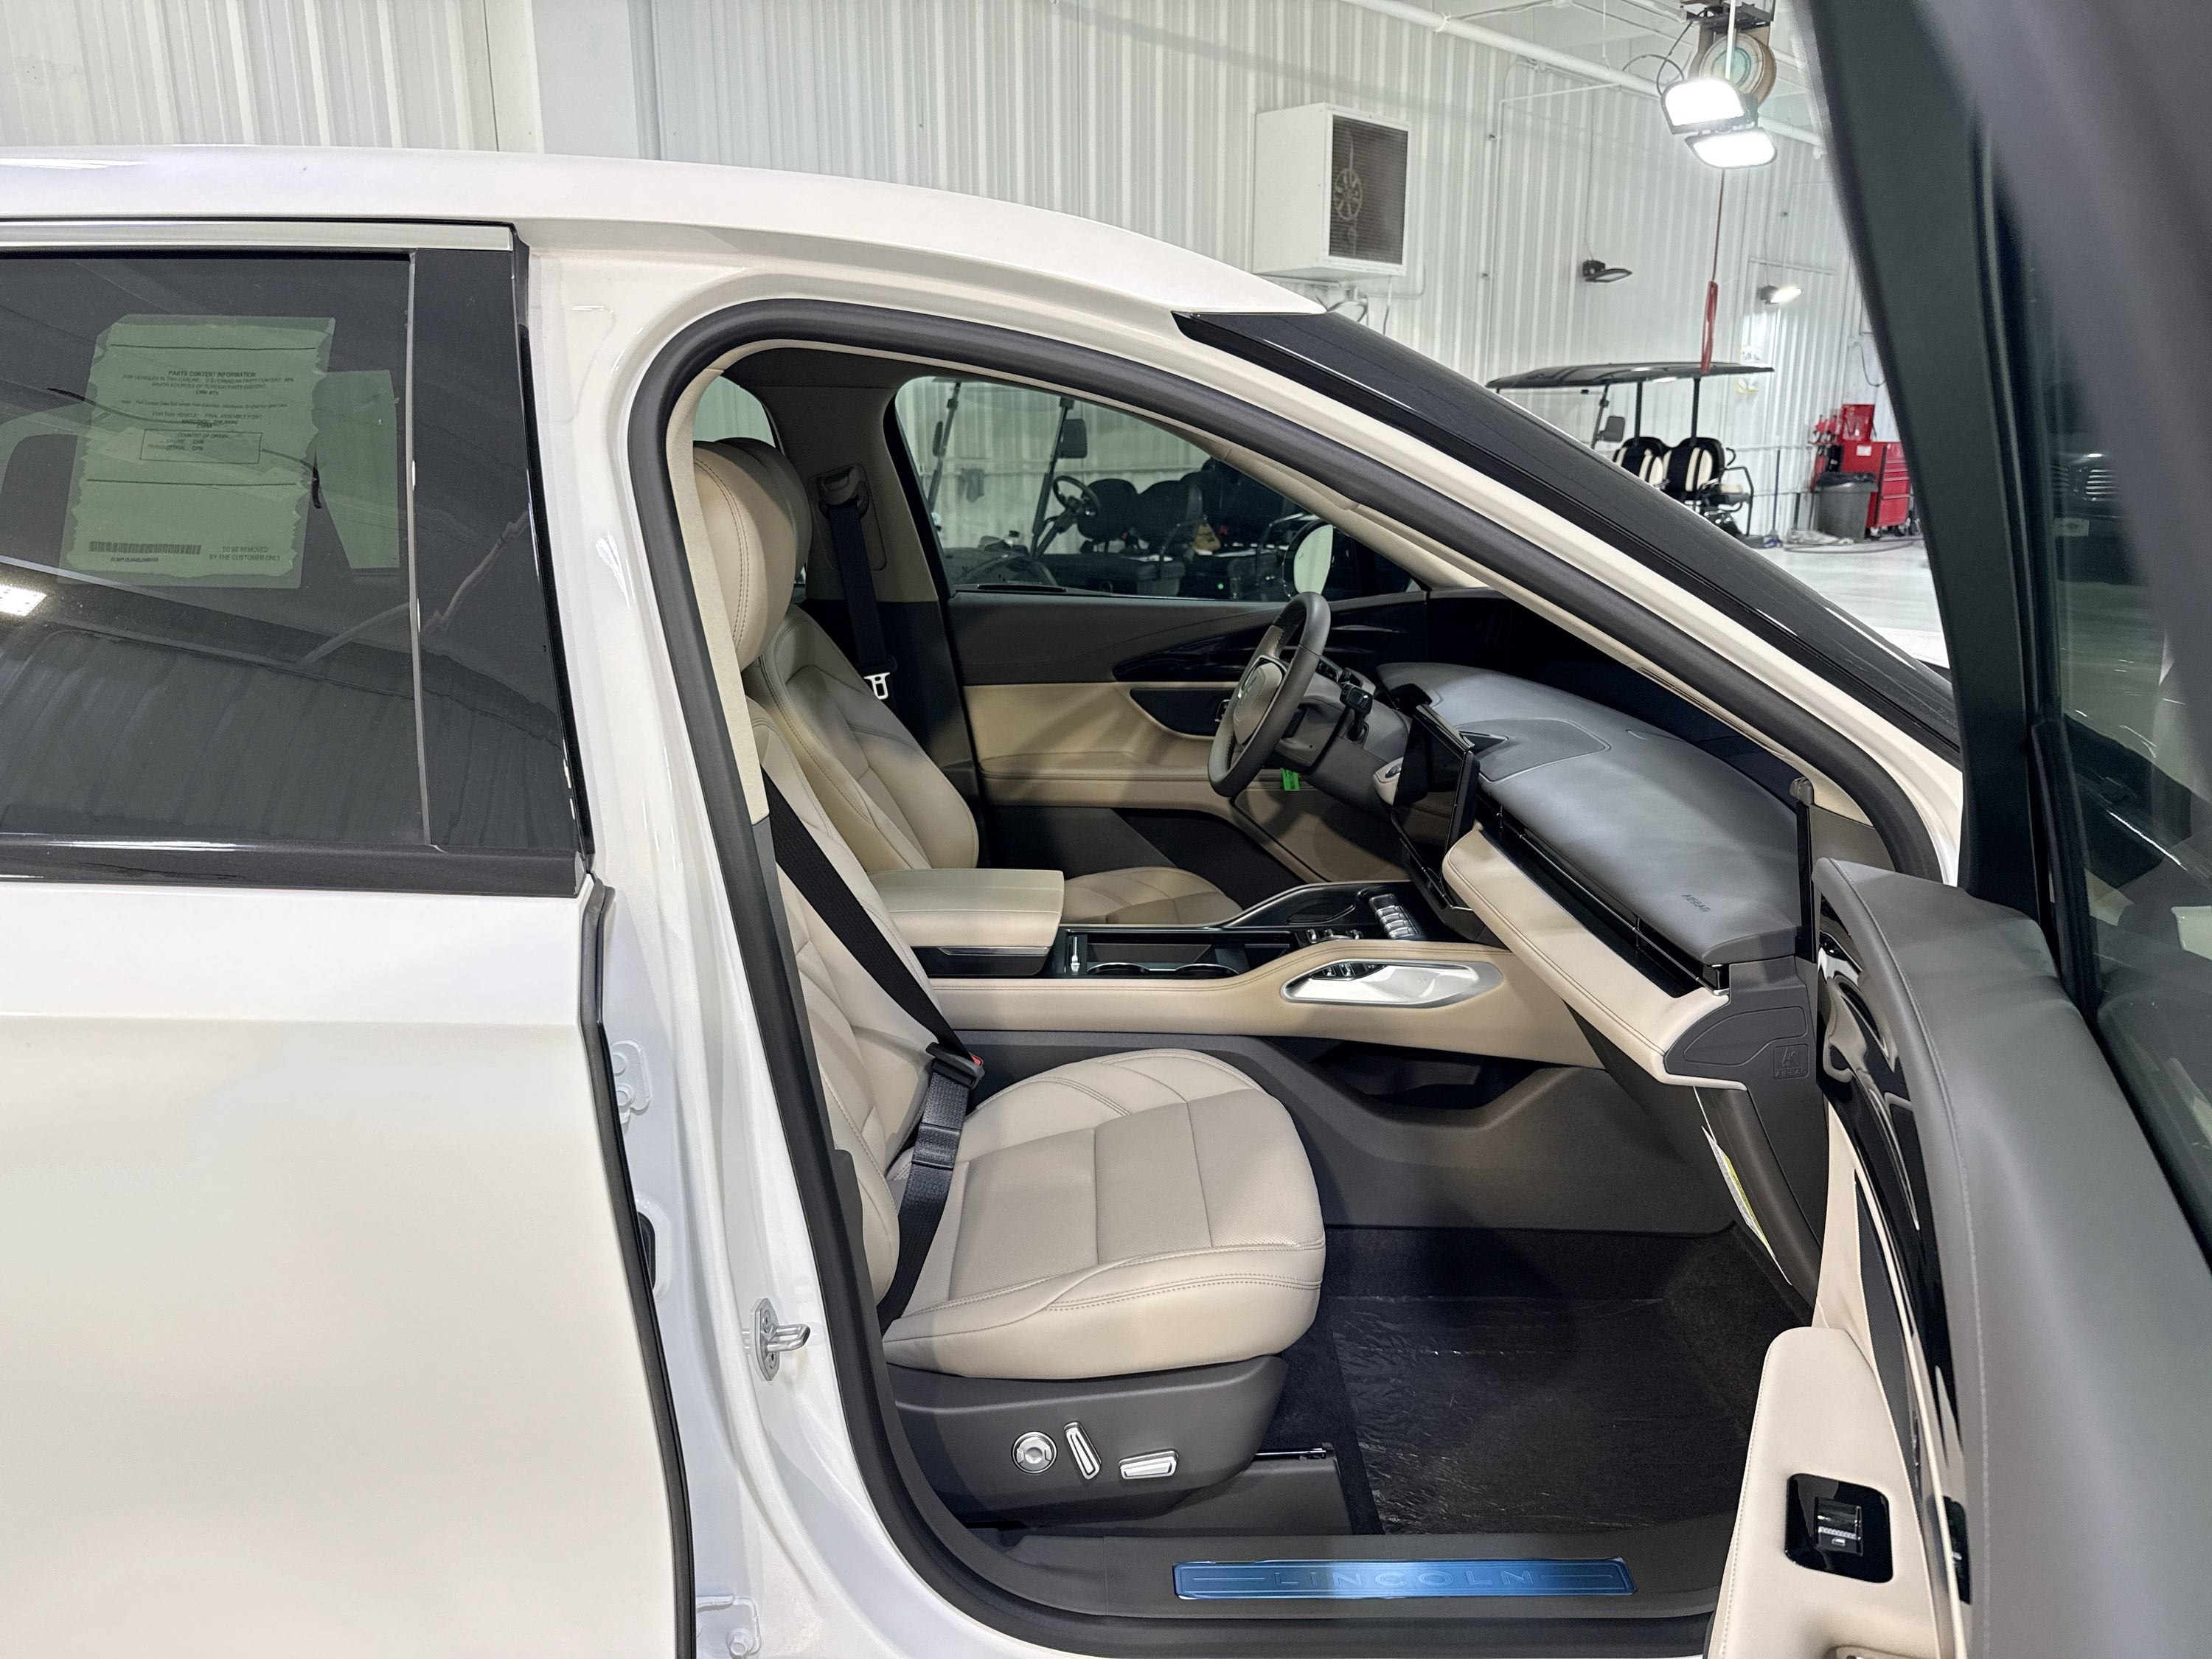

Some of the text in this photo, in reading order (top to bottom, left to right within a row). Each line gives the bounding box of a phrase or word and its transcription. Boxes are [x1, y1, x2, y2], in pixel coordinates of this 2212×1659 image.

[1680, 894, 1711, 913] AIRBAG
[1775, 1068, 1808, 1077] AIRBAG
[1273, 1569, 1534, 1587] LINCOLN
